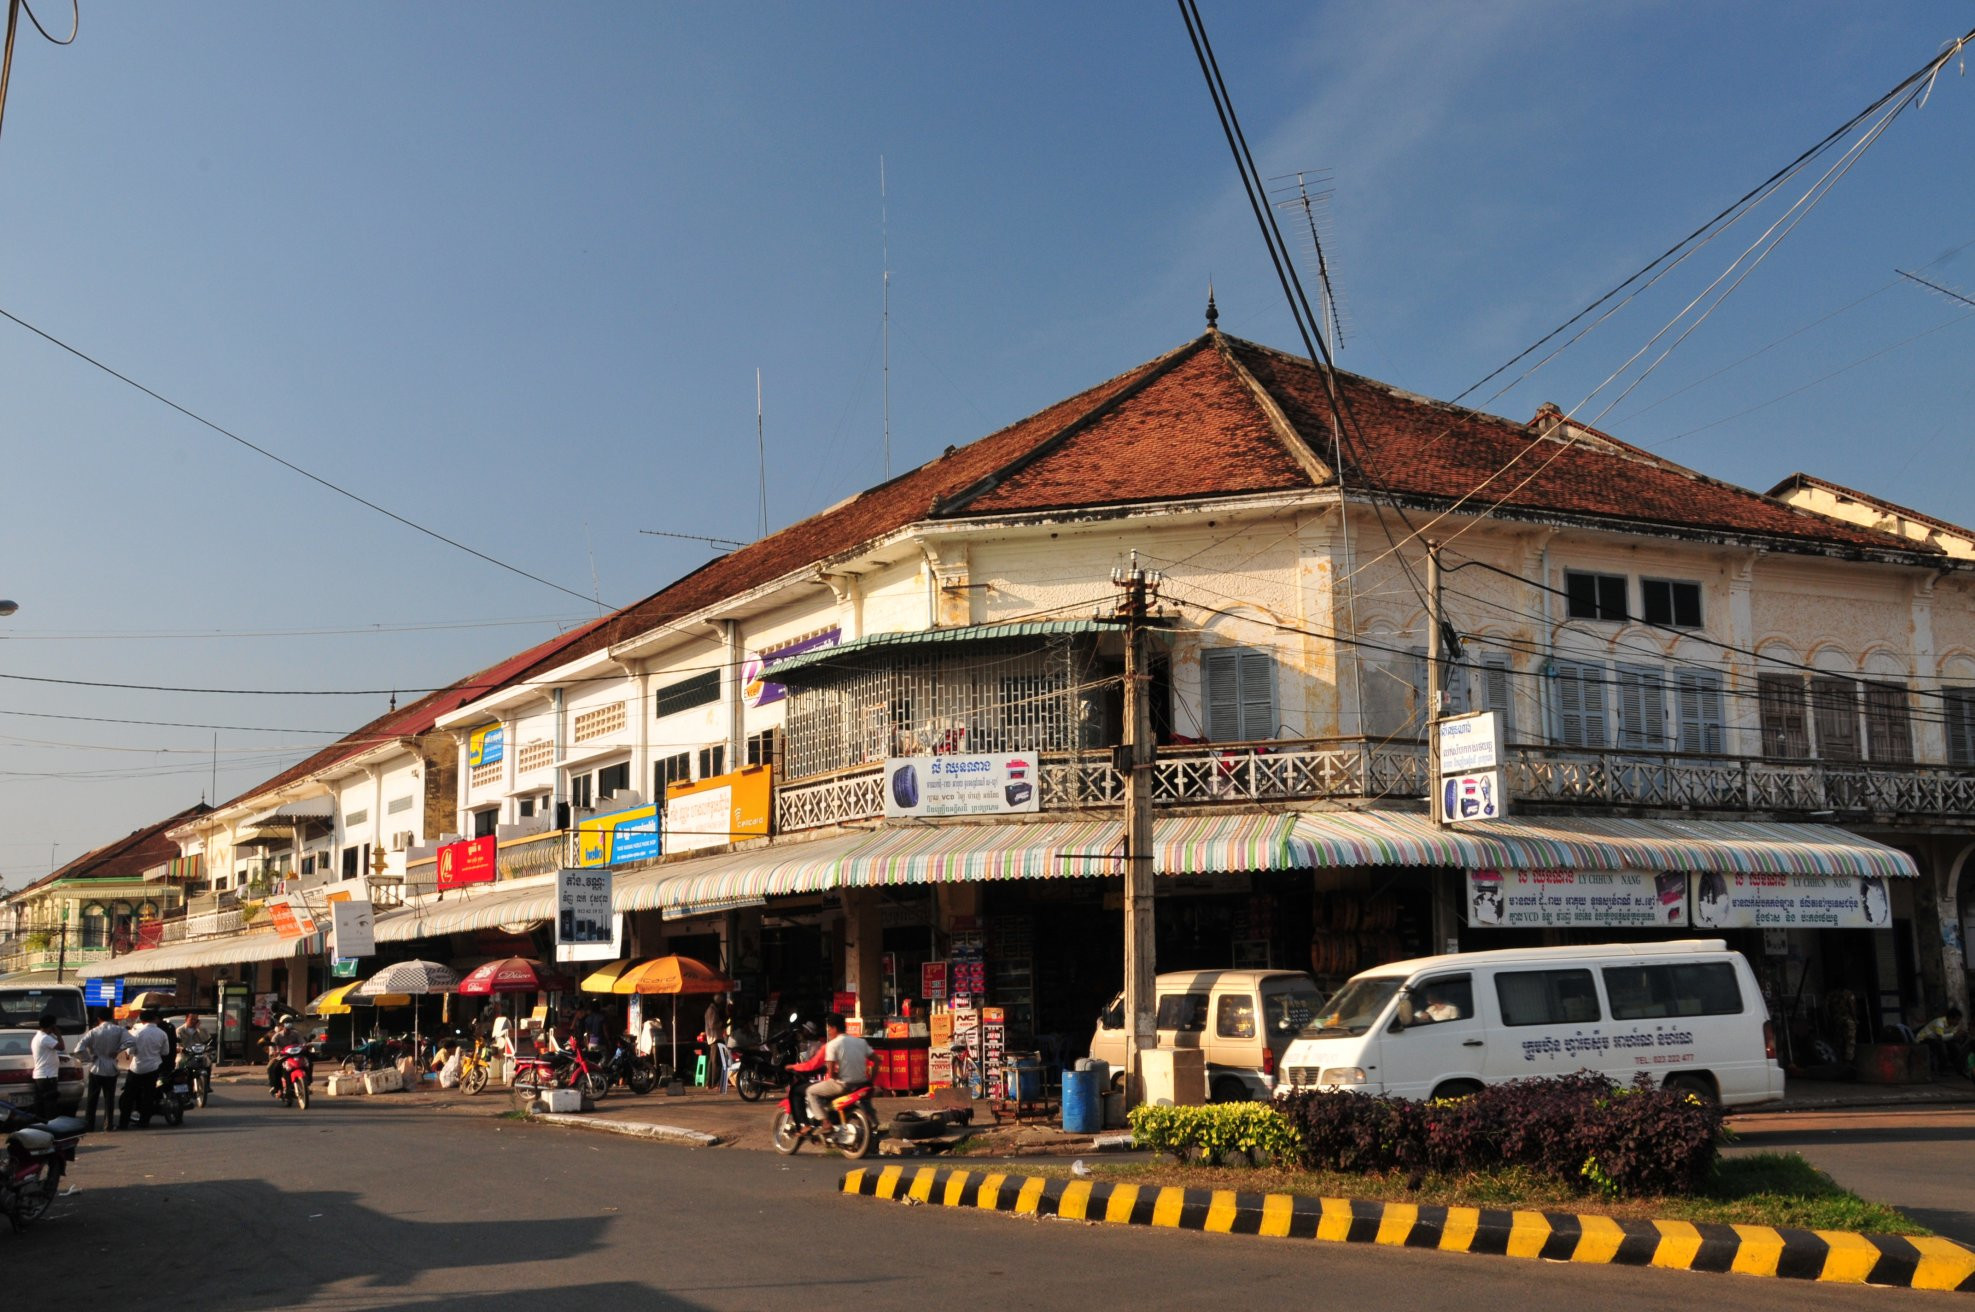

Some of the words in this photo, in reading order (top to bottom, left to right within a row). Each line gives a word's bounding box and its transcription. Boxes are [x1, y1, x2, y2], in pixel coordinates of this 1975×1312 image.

[586, 846, 603, 861] hello
[1578, 875, 1586, 884] LY
[1588, 875, 1613, 885] CHHUN
[1621, 875, 1641, 885] NANG
[1803, 878, 1826, 888] CHHUN
[1833, 878, 1852, 888] NANG
[1523, 912, 1539, 922] VCD
